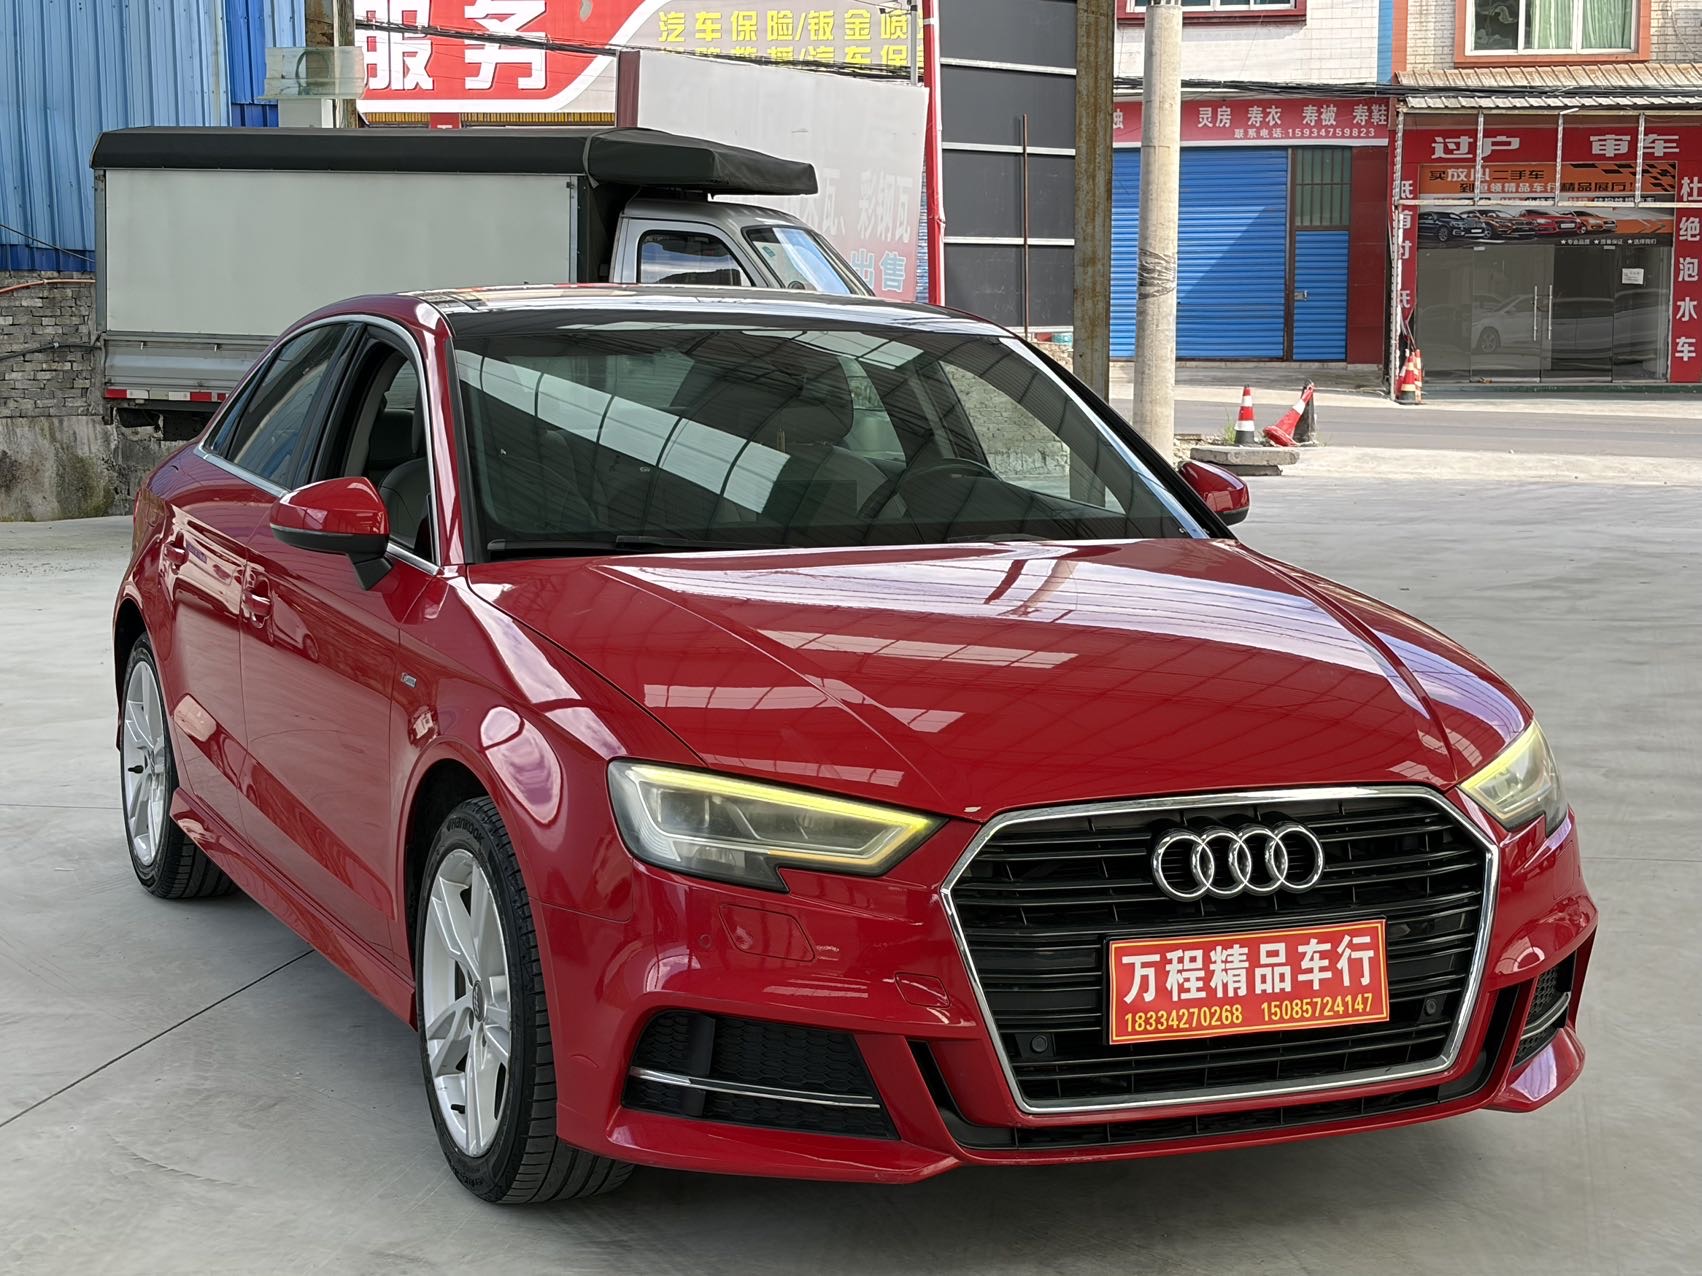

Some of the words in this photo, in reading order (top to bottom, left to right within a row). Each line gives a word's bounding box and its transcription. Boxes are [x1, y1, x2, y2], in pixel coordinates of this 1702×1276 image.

[353, 0, 546, 91] 服务
[657, 8, 923, 43] 汽车保险/钣金喷
[1198, 106, 1232, 128] 灵房
[1247, 106, 1282, 127] 寿衣
[1302, 104, 1337, 126] 寿被
[1352, 103, 1388, 126] 寿鞋
[1431, 135, 1520, 159] 过户
[1590, 134, 1680, 158] 审车
[850, 248, 907, 293] 出售
[1674, 175, 1702, 362] 杜绝泡水车
[1121, 934, 1375, 1004] 万程精品车行
[1124, 1004, 1243, 1032] 18334270268
[1261, 992, 1373, 1022] 15085724147
